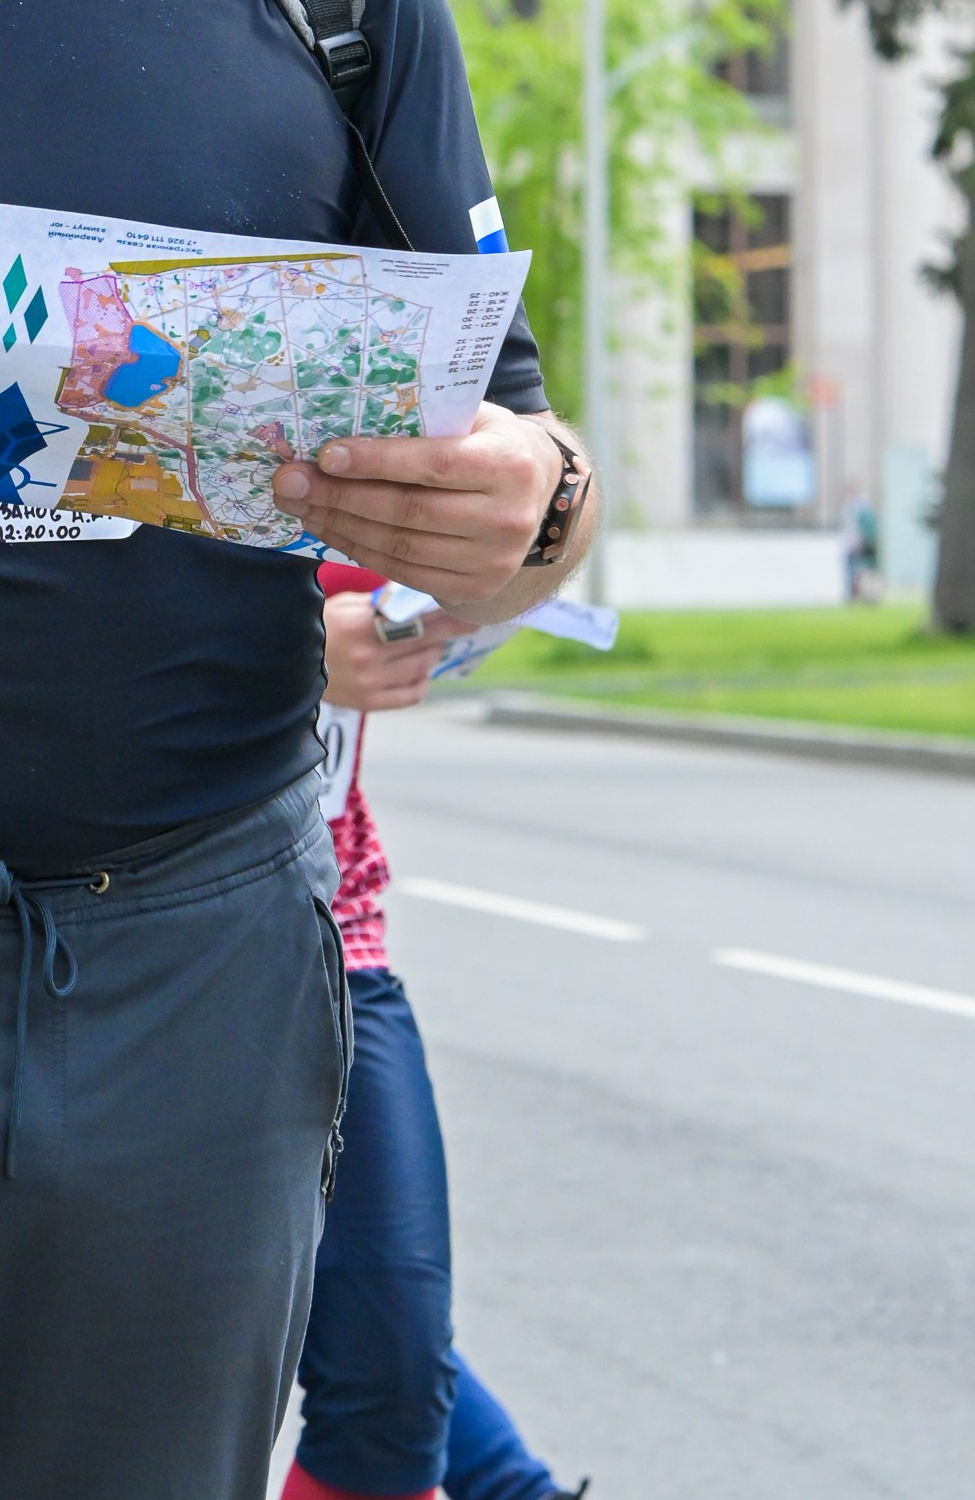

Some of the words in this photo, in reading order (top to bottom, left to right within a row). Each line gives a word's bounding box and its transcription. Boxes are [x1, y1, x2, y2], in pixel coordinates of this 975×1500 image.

[73, 224, 106, 233] азимут
[48, 231, 105, 243] Аварийный
[127, 232, 149, 240] 6410
[116, 239, 144, 247] связь
[146, 244, 203, 255] Экстренная
